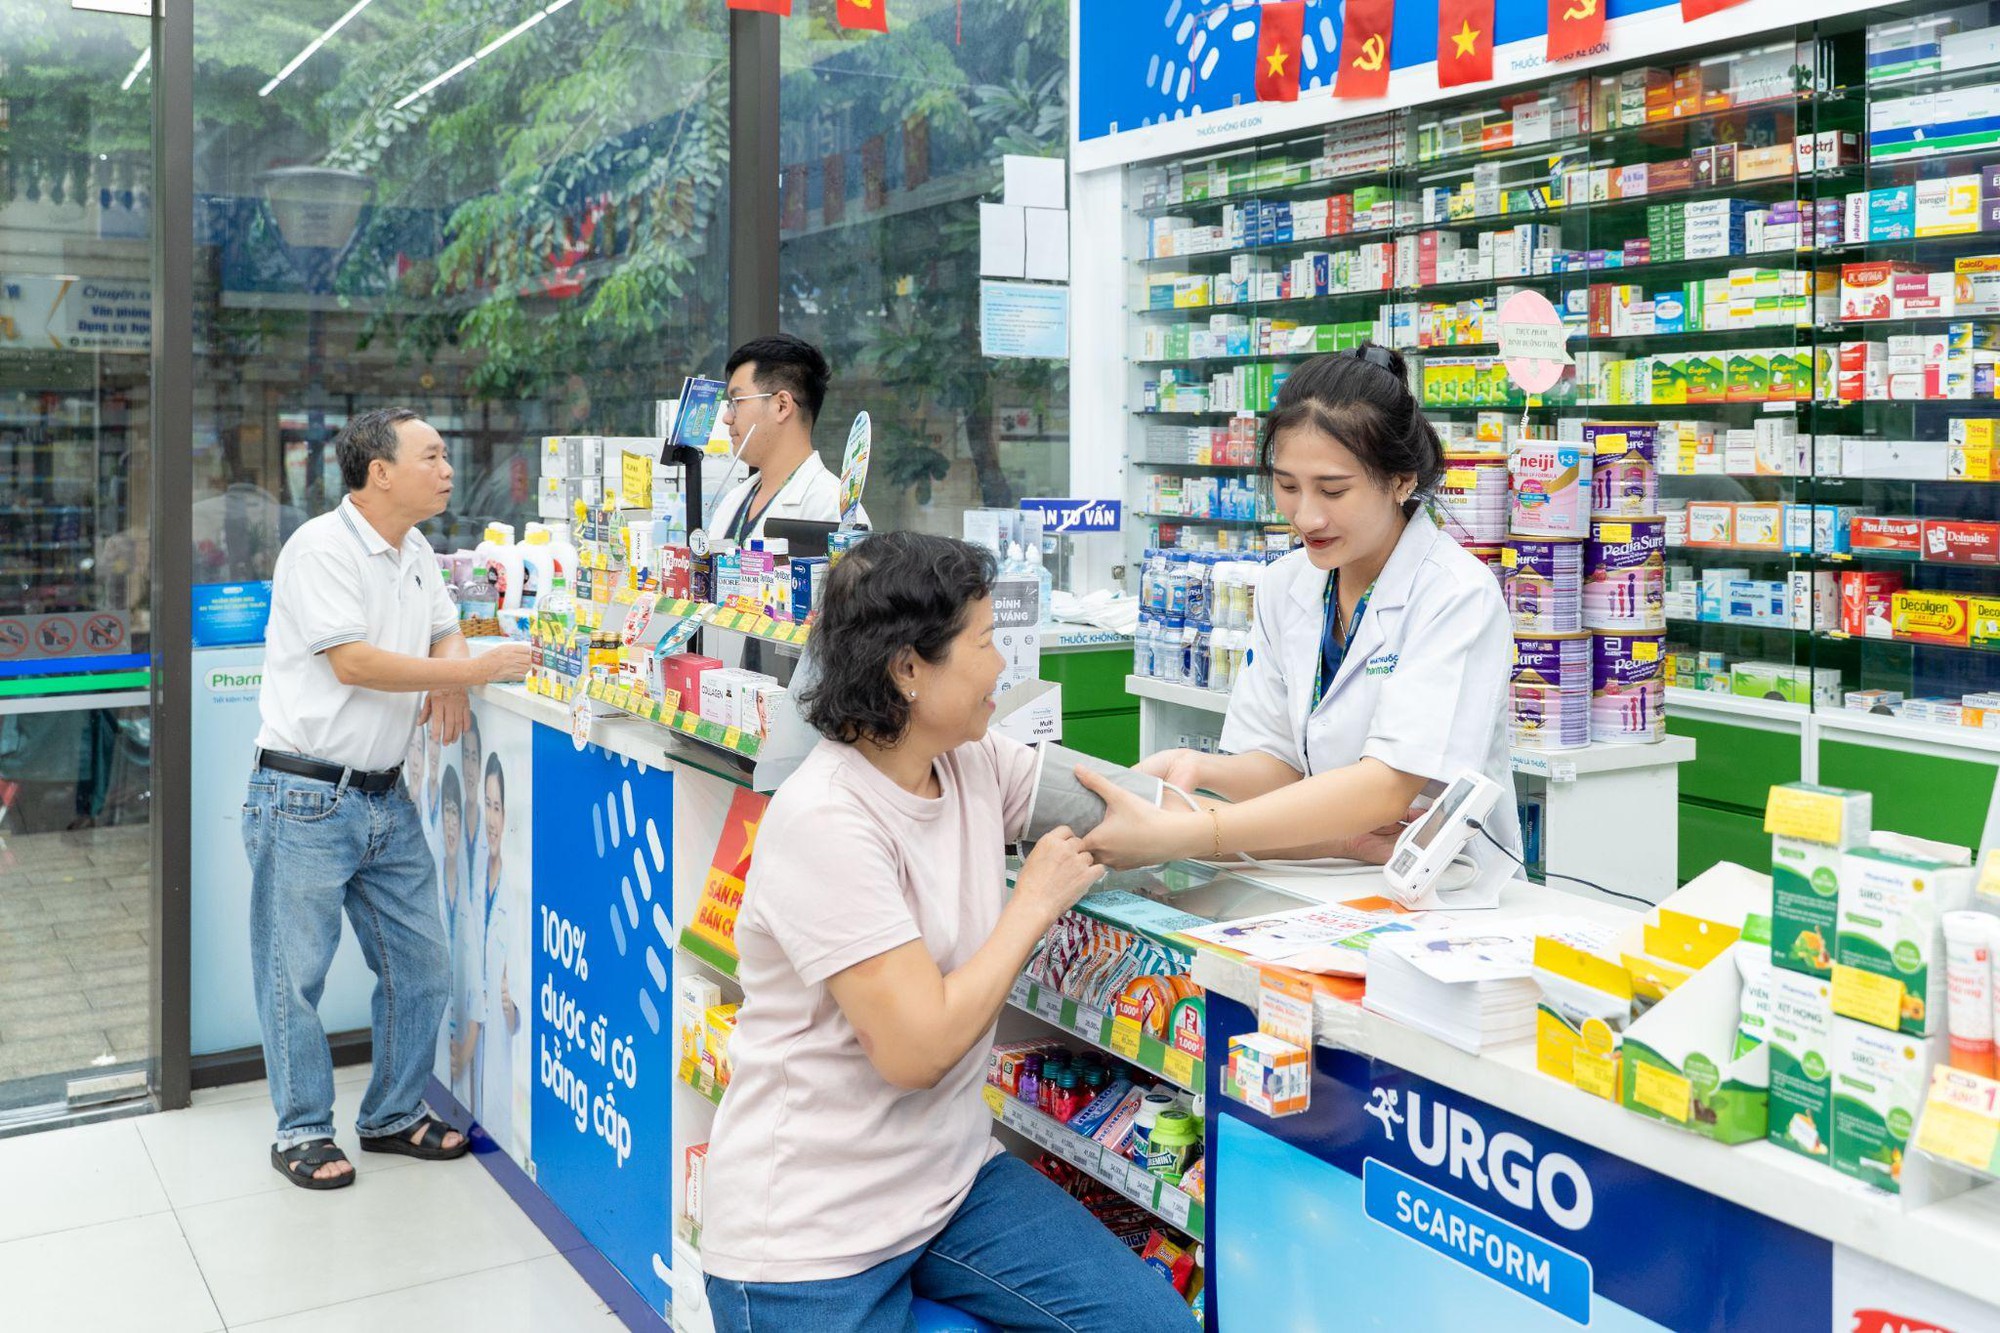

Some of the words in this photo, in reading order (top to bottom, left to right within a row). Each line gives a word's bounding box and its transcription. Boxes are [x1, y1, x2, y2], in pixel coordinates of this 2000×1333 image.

[1511, 57, 1539, 71] THUỐC
[1085, 503, 1115, 526] VẤN
[1692, 511, 1724, 523] Strepsils
[1737, 512, 1771, 524] Strepsils
[1602, 534, 1664, 561] PediaSure
[1946, 530, 1990, 543] Dolnaltic
[1000, 610, 1029, 622] VÁNG
[1900, 597, 1949, 615] Decolgen
[1060, 633, 1088, 644] THUỐC
[1089, 633, 1119, 643] KHÔNG
[1032, 727, 1053, 735] Vitamin
[1039, 719, 1053, 727] Multi
[708, 877, 730, 905] SẢN
[698, 905, 722, 931] BÁN
[541, 904, 588, 982] 100%
[541, 972, 586, 1053] dược
[590, 1013, 608, 1067] sĩ
[611, 1034, 637, 1089] có
[541, 1032, 588, 1134] bằng
[593, 1081, 632, 1169] cấp
[1078, 1081, 1120, 1125] mentos
[1407, 1090, 1594, 1231] URGO
[1396, 1190, 1550, 1295] SCARFORM
